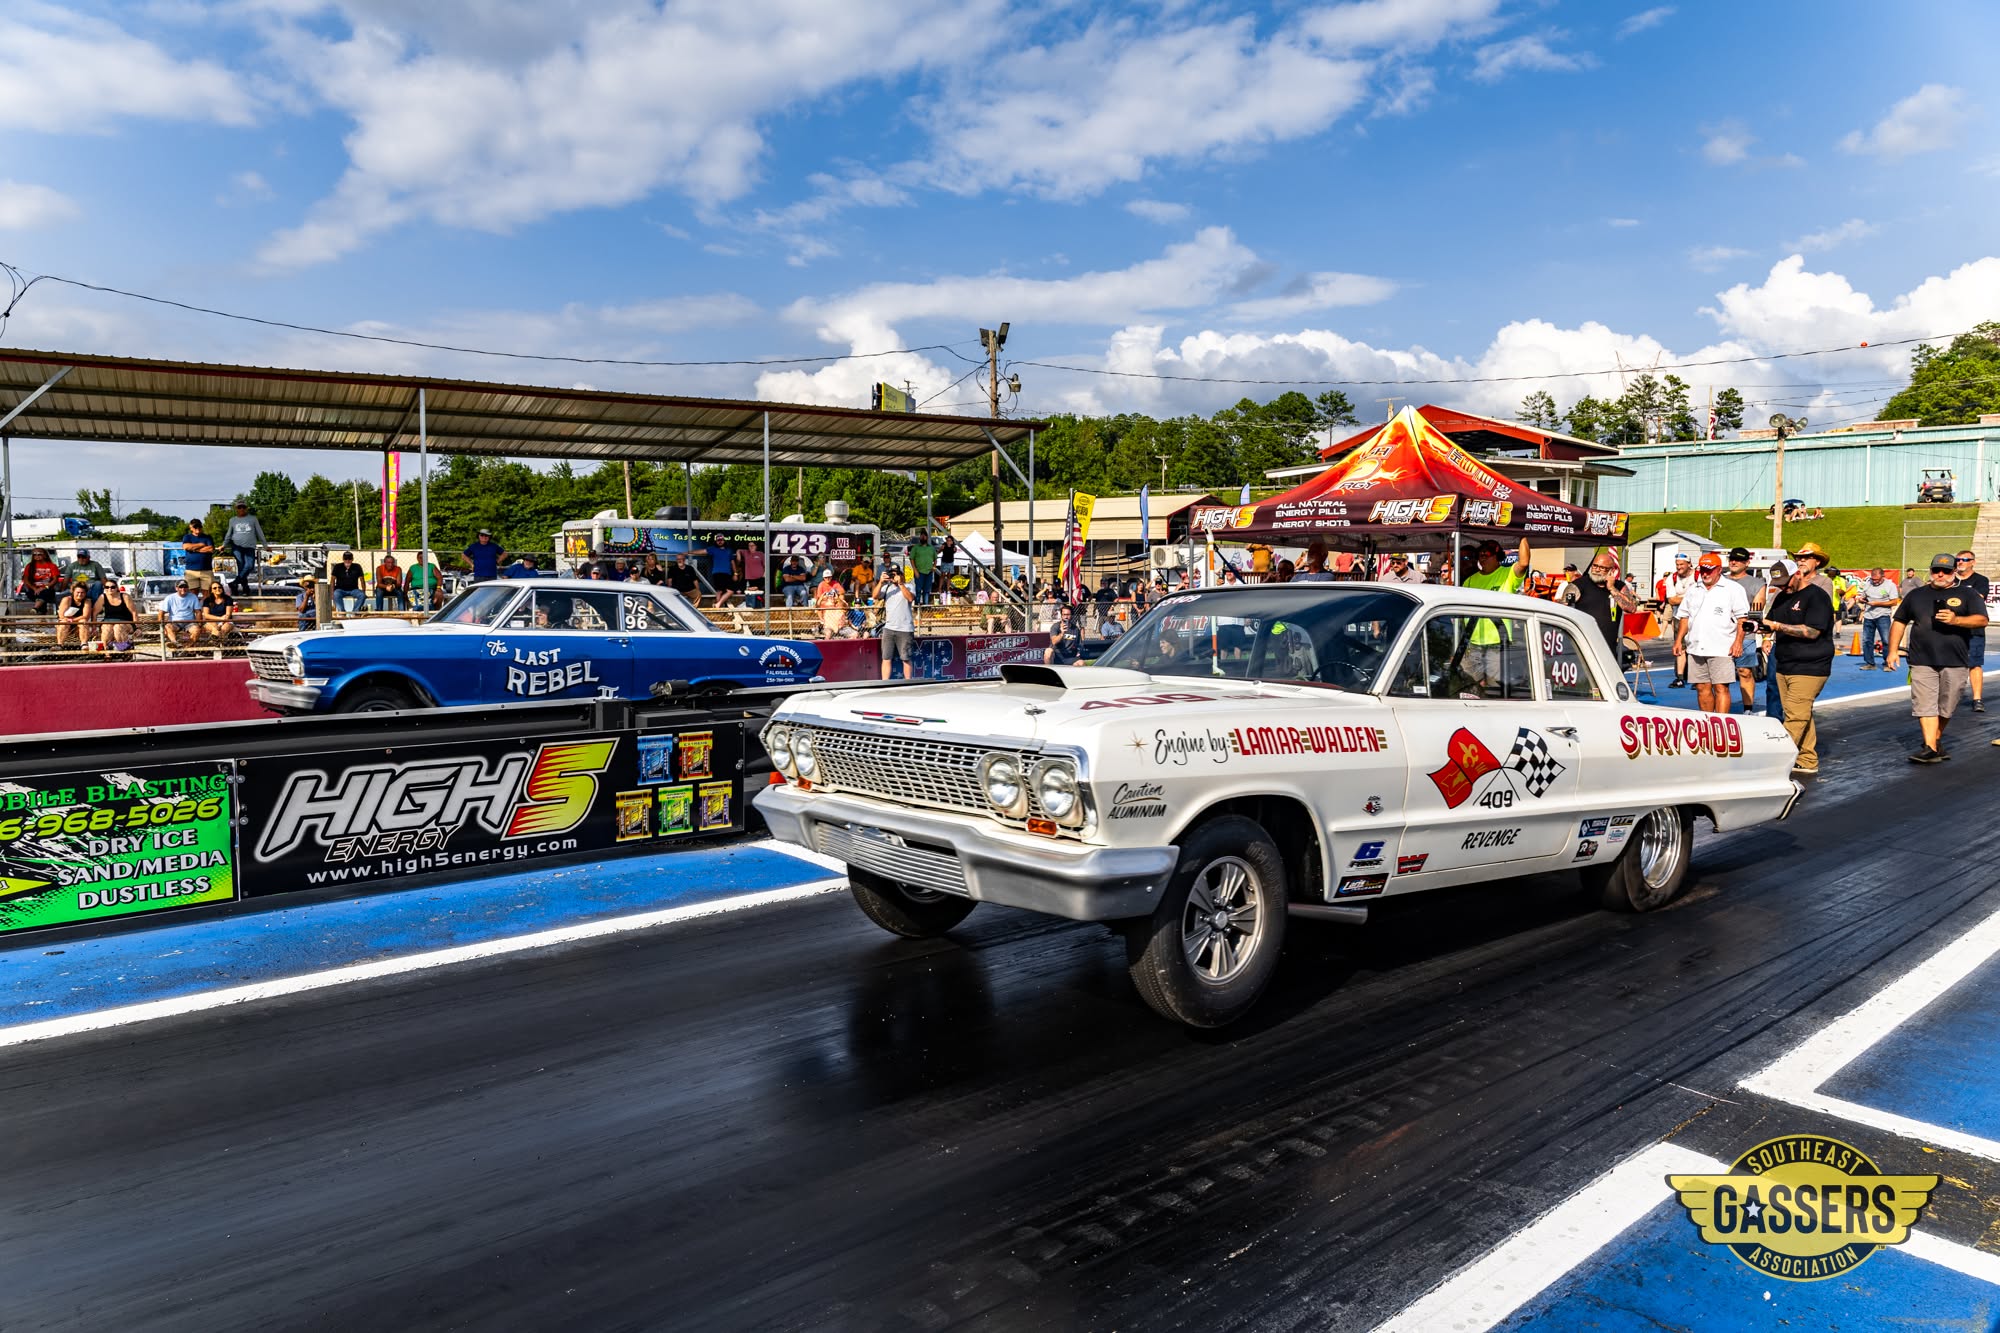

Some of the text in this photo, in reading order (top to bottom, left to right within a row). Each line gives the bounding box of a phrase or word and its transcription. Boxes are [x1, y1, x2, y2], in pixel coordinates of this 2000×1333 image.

[1275, 508, 1348, 518] ENERGY PILLS
[1276, 500, 1346, 510] ALL NATURAL
[1540, 504, 1571, 514] NATURAL
[1271, 519, 1350, 529] ENERGY SHOTS
[1526, 512, 1573, 522] ENERGY PILLS
[653, 533, 670, 541] The
[673, 533, 698, 541] Tase
[700, 532, 711, 542] of
[1524, 523, 1574, 534] ENERGY SHOTS
[771, 534, 827, 554] 423
[836, 538, 850, 548] WE
[624, 595, 648, 617] S/S
[625, 615, 648, 630] 96
[487, 640, 508, 656] The
[1542, 630, 1563, 656] S/S
[514, 648, 561, 666] LAST
[506, 660, 600, 696] REBEL
[1551, 661, 1577, 686] 409
[1079, 693, 1218, 710] 409
[1154, 728, 1206, 766] Engine
[1234, 726, 1305, 756] LAMAR
[1306, 726, 1381, 754] WALDEN
[86, 774, 228, 803] BLASTING
[1112, 782, 1166, 805] Caution
[1479, 789, 1513, 809] 409
[254, 752, 535, 863] HIGH
[1107, 804, 1168, 819] ALUMINUM
[0, 797, 221, 841] 6-968-5026
[89, 829, 198, 857] DRY ICE
[324, 824, 461, 863] ENERGY
[1461, 828, 1522, 850] REVENGE
[57, 850, 227, 886] SAND/MEDIA
[307, 836, 578, 884] www.high5energy.com
[78, 876, 211, 910] DUSTLESS
